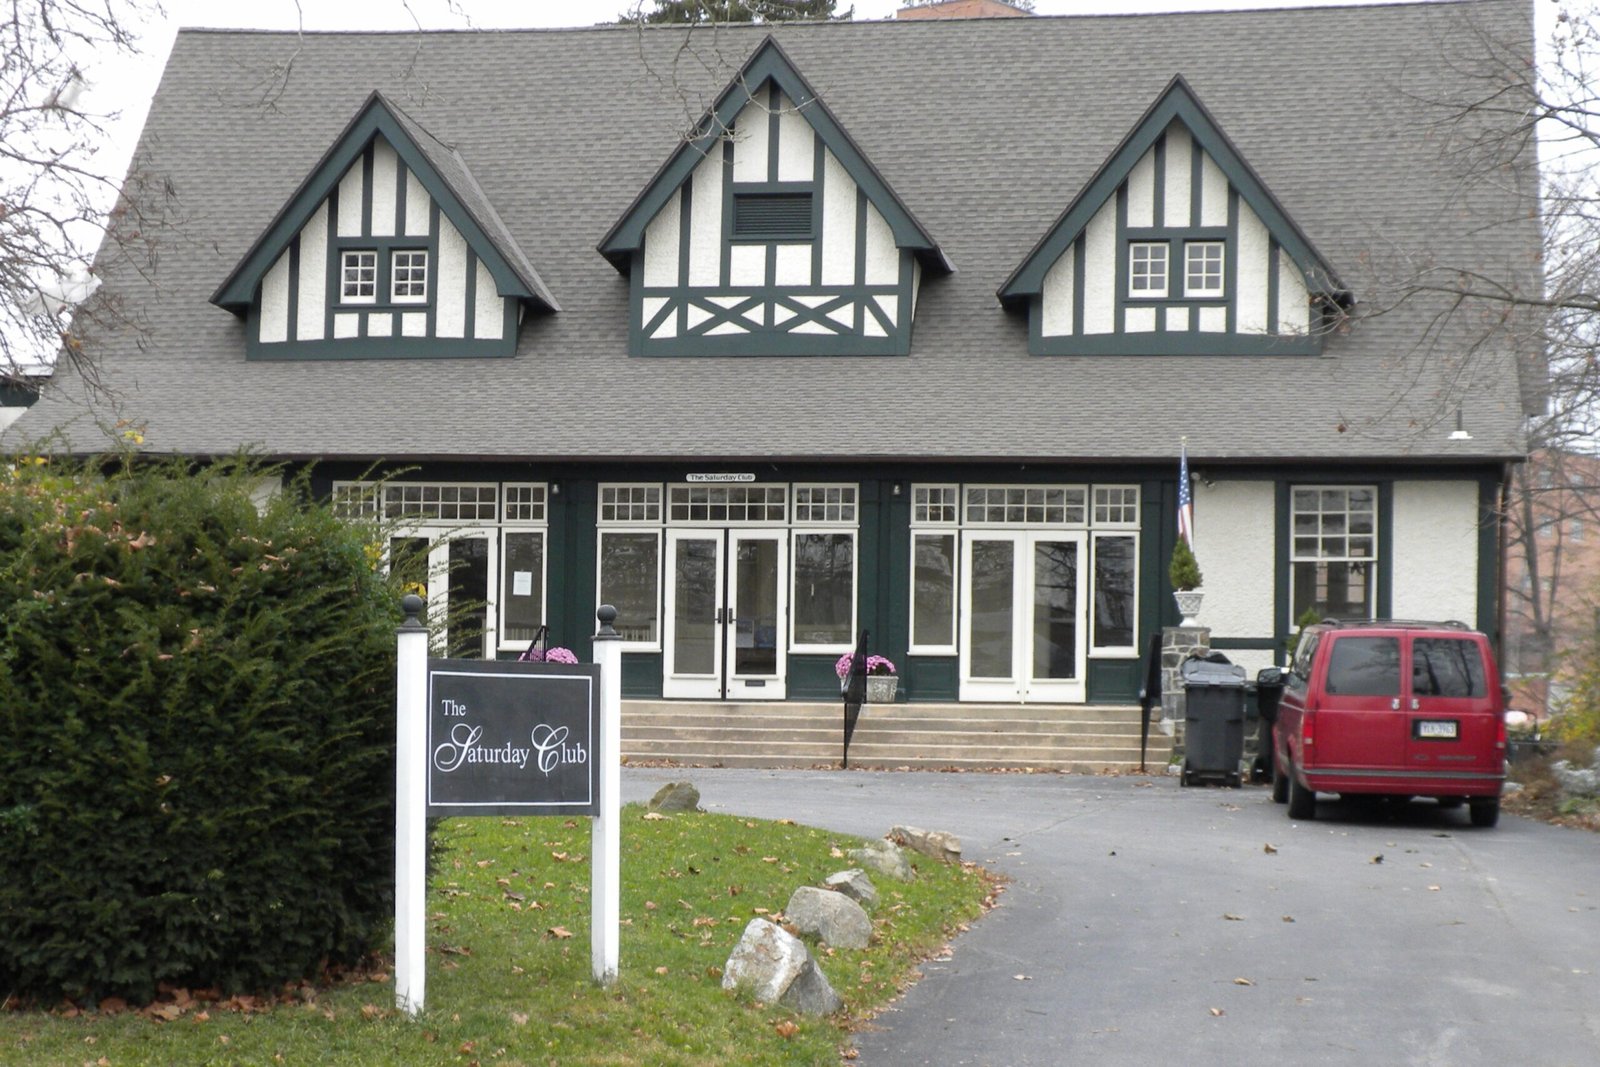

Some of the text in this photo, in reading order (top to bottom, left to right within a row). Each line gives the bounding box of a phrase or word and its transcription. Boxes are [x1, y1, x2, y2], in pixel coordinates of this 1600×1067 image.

[441, 699, 467, 717] The
[433, 723, 587, 778] Saturday Club
